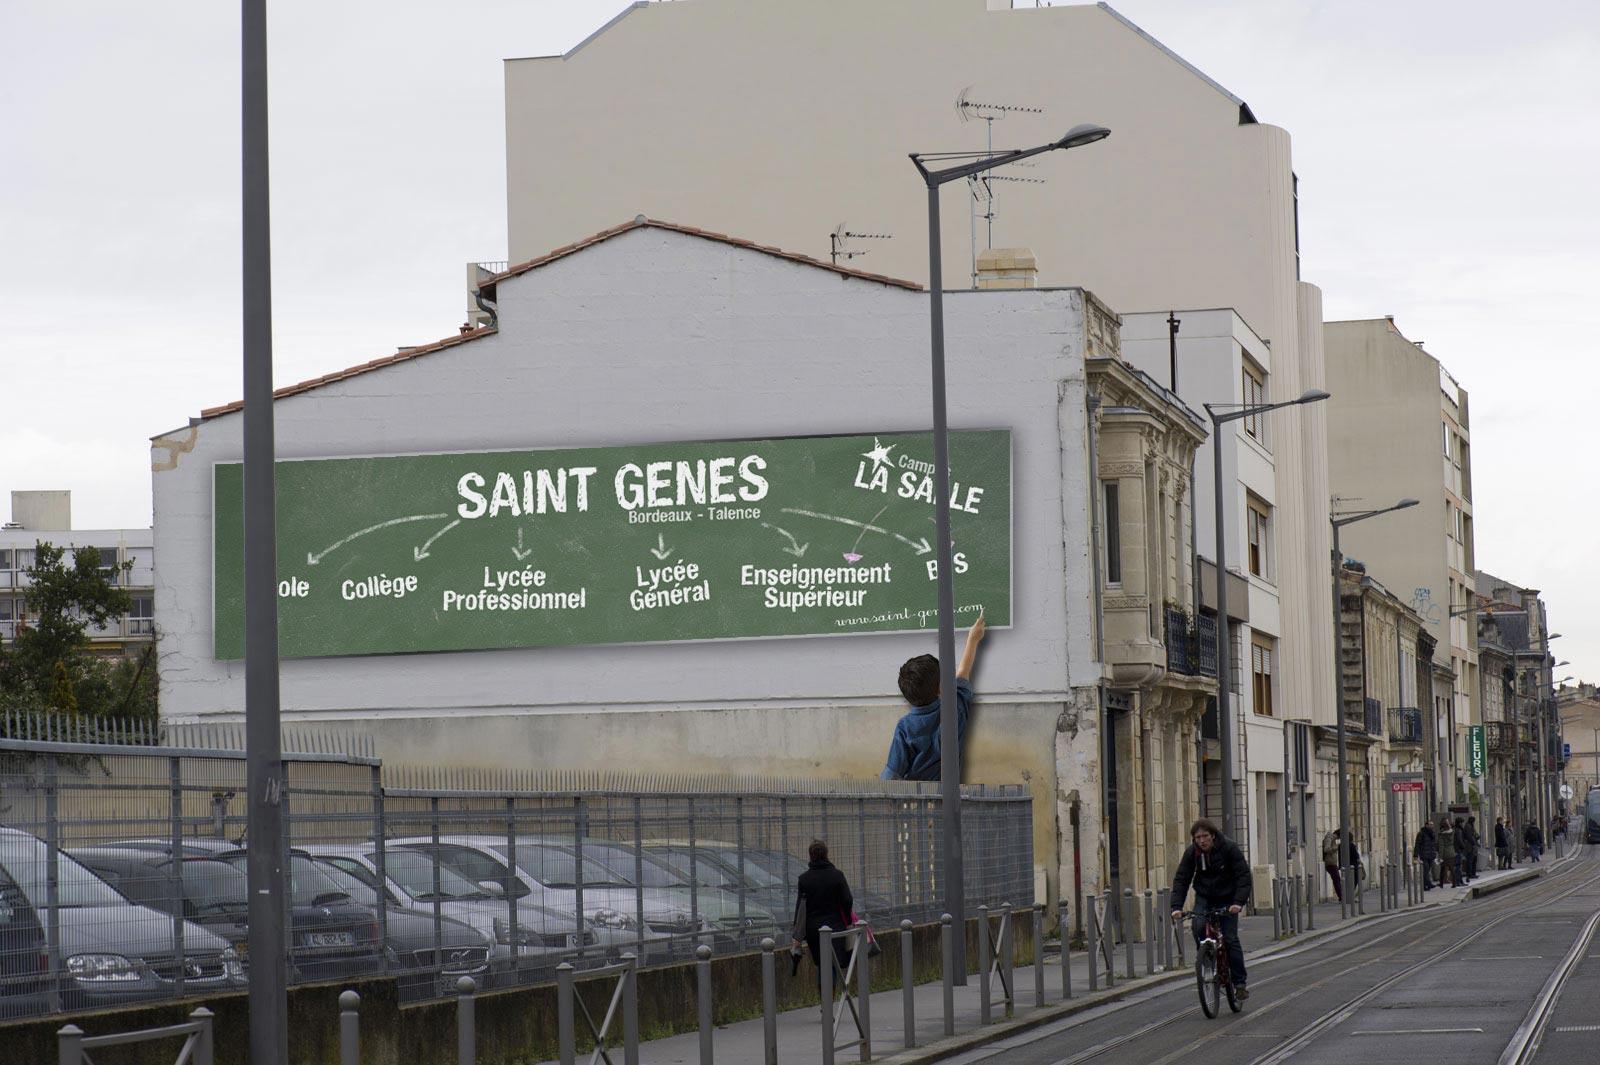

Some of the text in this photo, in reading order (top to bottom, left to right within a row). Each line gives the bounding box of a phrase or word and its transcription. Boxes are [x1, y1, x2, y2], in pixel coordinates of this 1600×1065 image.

[898, 454, 952, 477] Camp
[456, 454, 769, 520] SAINT GENES
[854, 461, 984, 514] LA SALE
[628, 508, 692, 524] Bordeaux
[707, 505, 761, 521] Talence
[483, 565, 546, 590] Lycée
[636, 559, 699, 591] Lycée
[741, 562, 892, 589] Enseignement
[926, 552, 969, 581] BS
[278, 576, 310, 597] ole
[341, 573, 418, 601] Collège
[443, 587, 586, 611] Professionnel
[629, 580, 710, 611] Général
[764, 585, 867, 612] Supérieur
[1472, 727, 1482, 776] FLEURS
